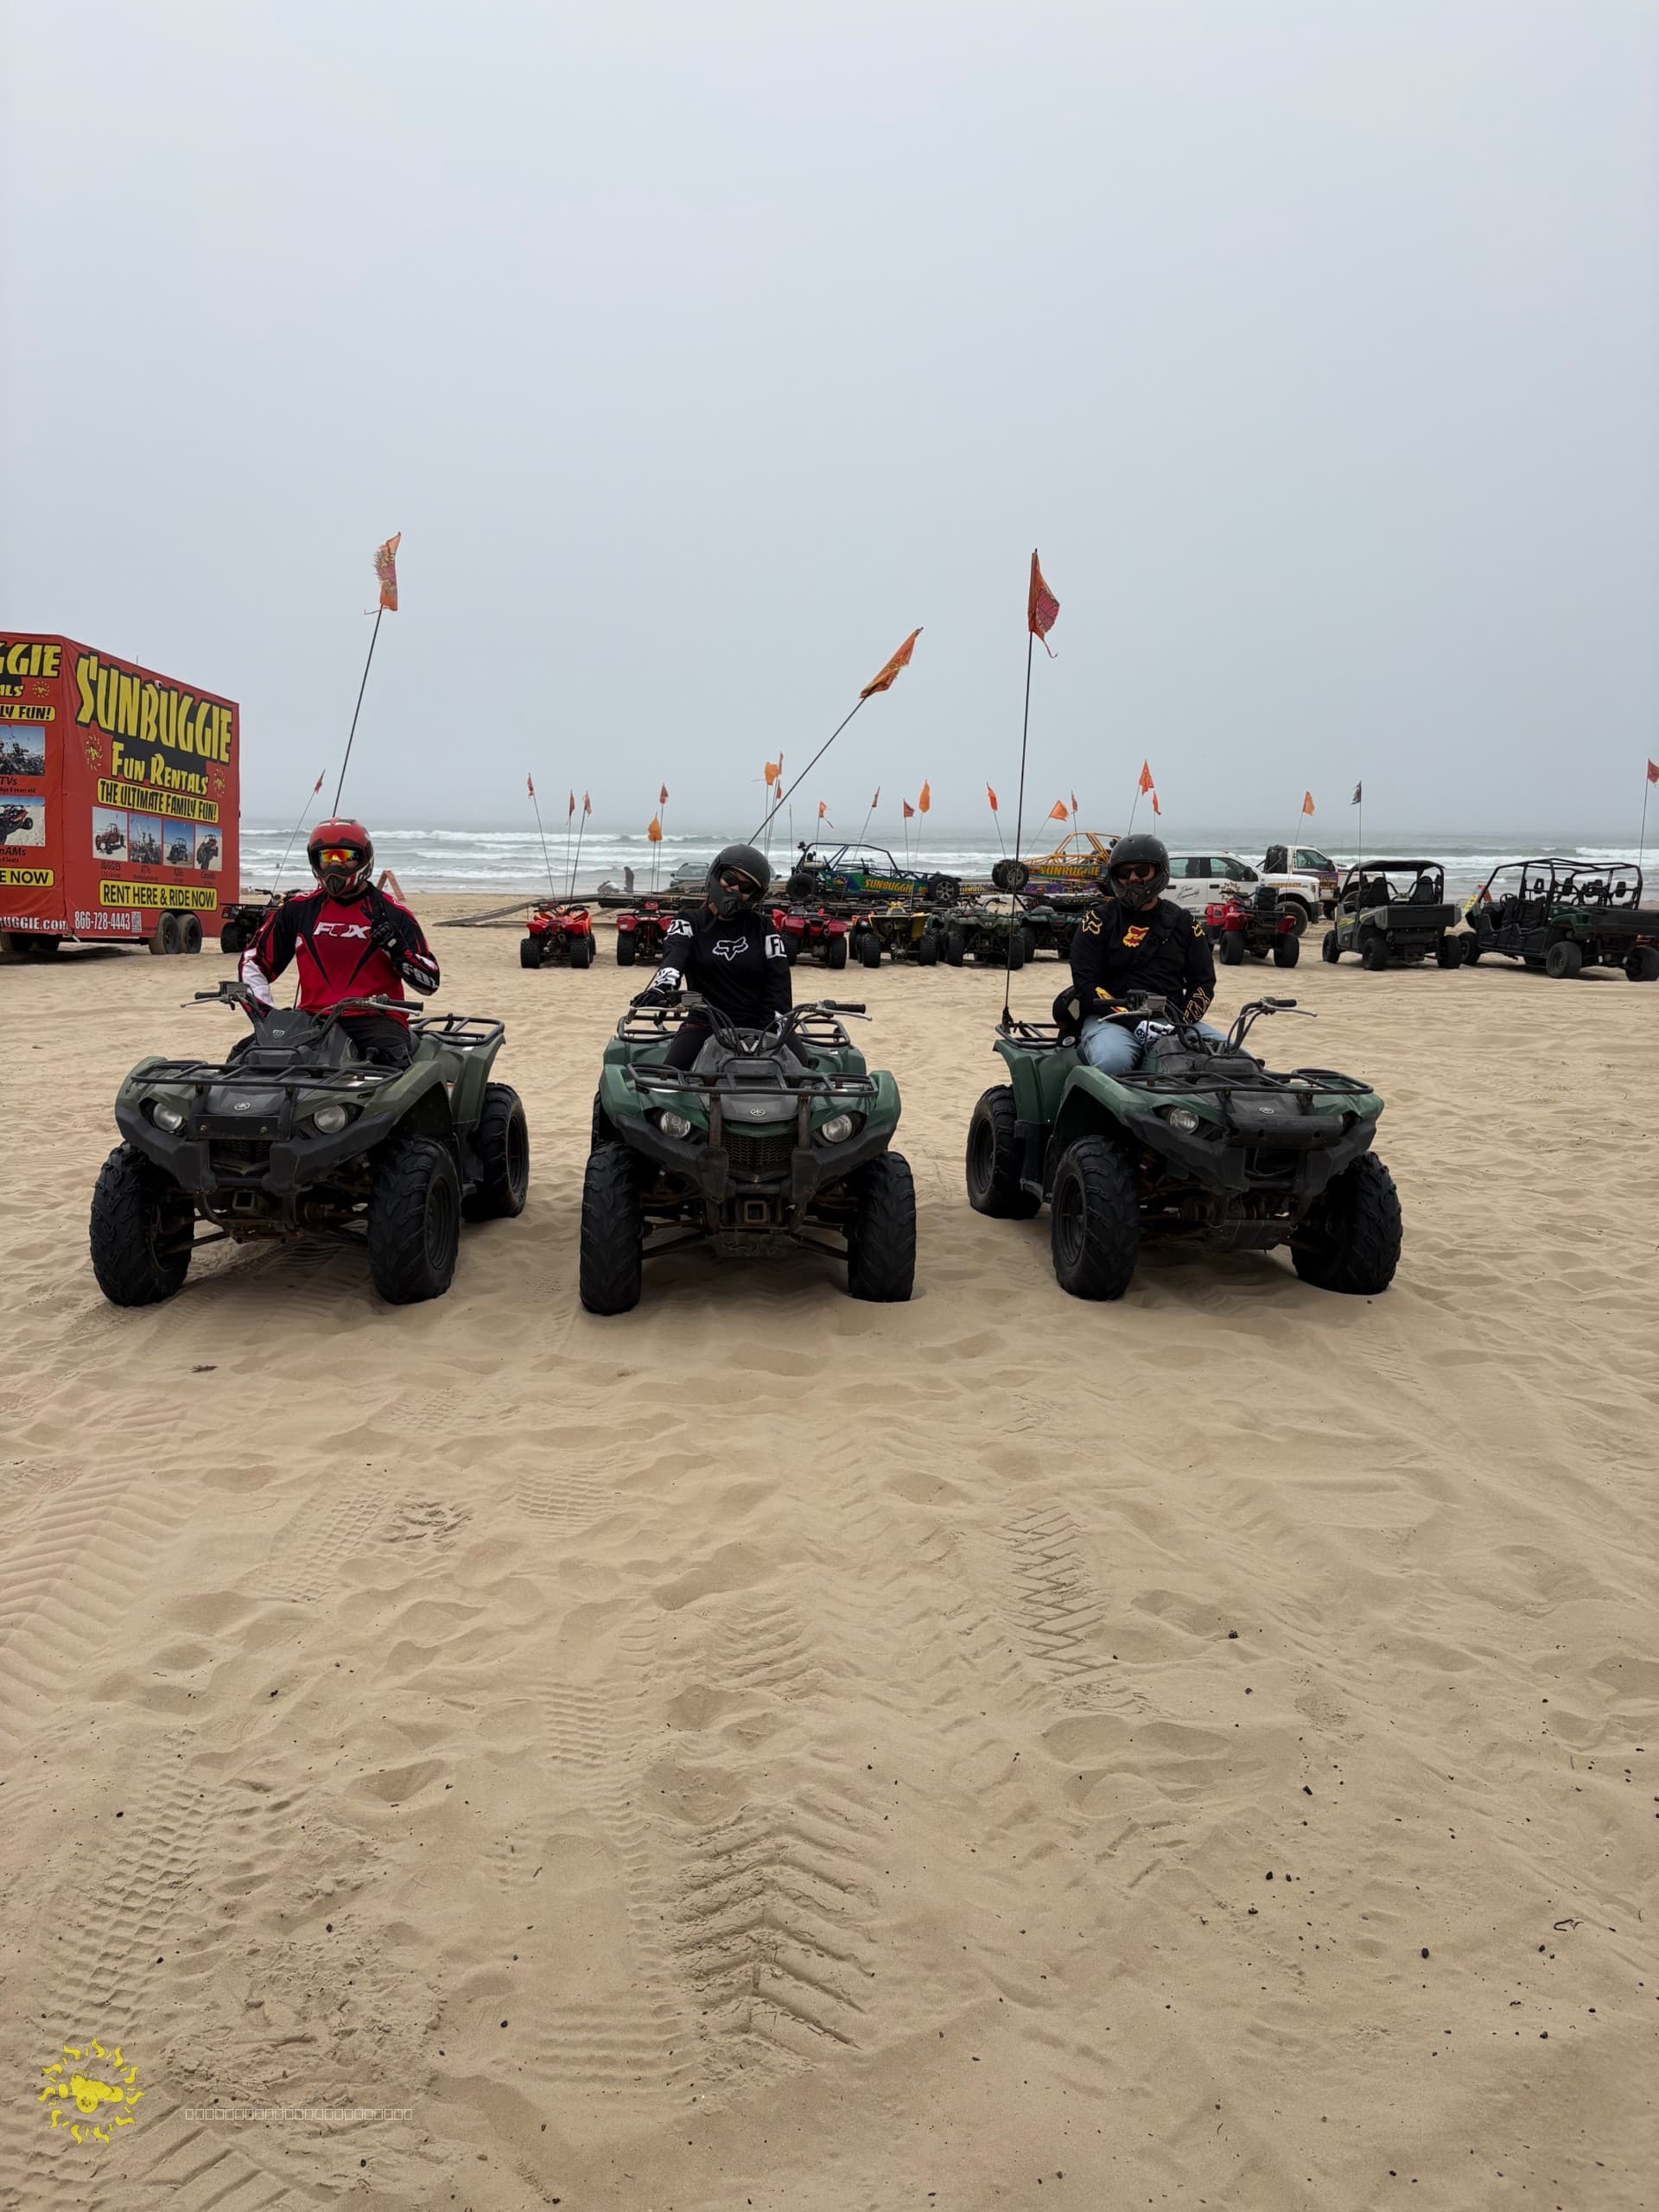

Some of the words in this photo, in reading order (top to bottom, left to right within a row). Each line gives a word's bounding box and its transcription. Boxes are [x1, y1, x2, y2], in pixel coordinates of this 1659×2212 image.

[0, 643, 61, 677] GIE
[19, 706, 52, 720] FUN!
[76, 654, 232, 764] SUNBUGGIE
[100, 780, 118, 803] THE
[120, 785, 164, 810] ULTIMATE
[165, 794, 197, 816] FAMILY
[198, 800, 217, 821] FUN!
[10, 871, 49, 884] NOW
[104, 884, 130, 904] RENT
[132, 887, 158, 905] HERE
[160, 888, 168, 906] &
[169, 889, 190, 906] RIDE
[192, 891, 215, 908] NOW
[74, 911, 130, 931] 866-728-4443
